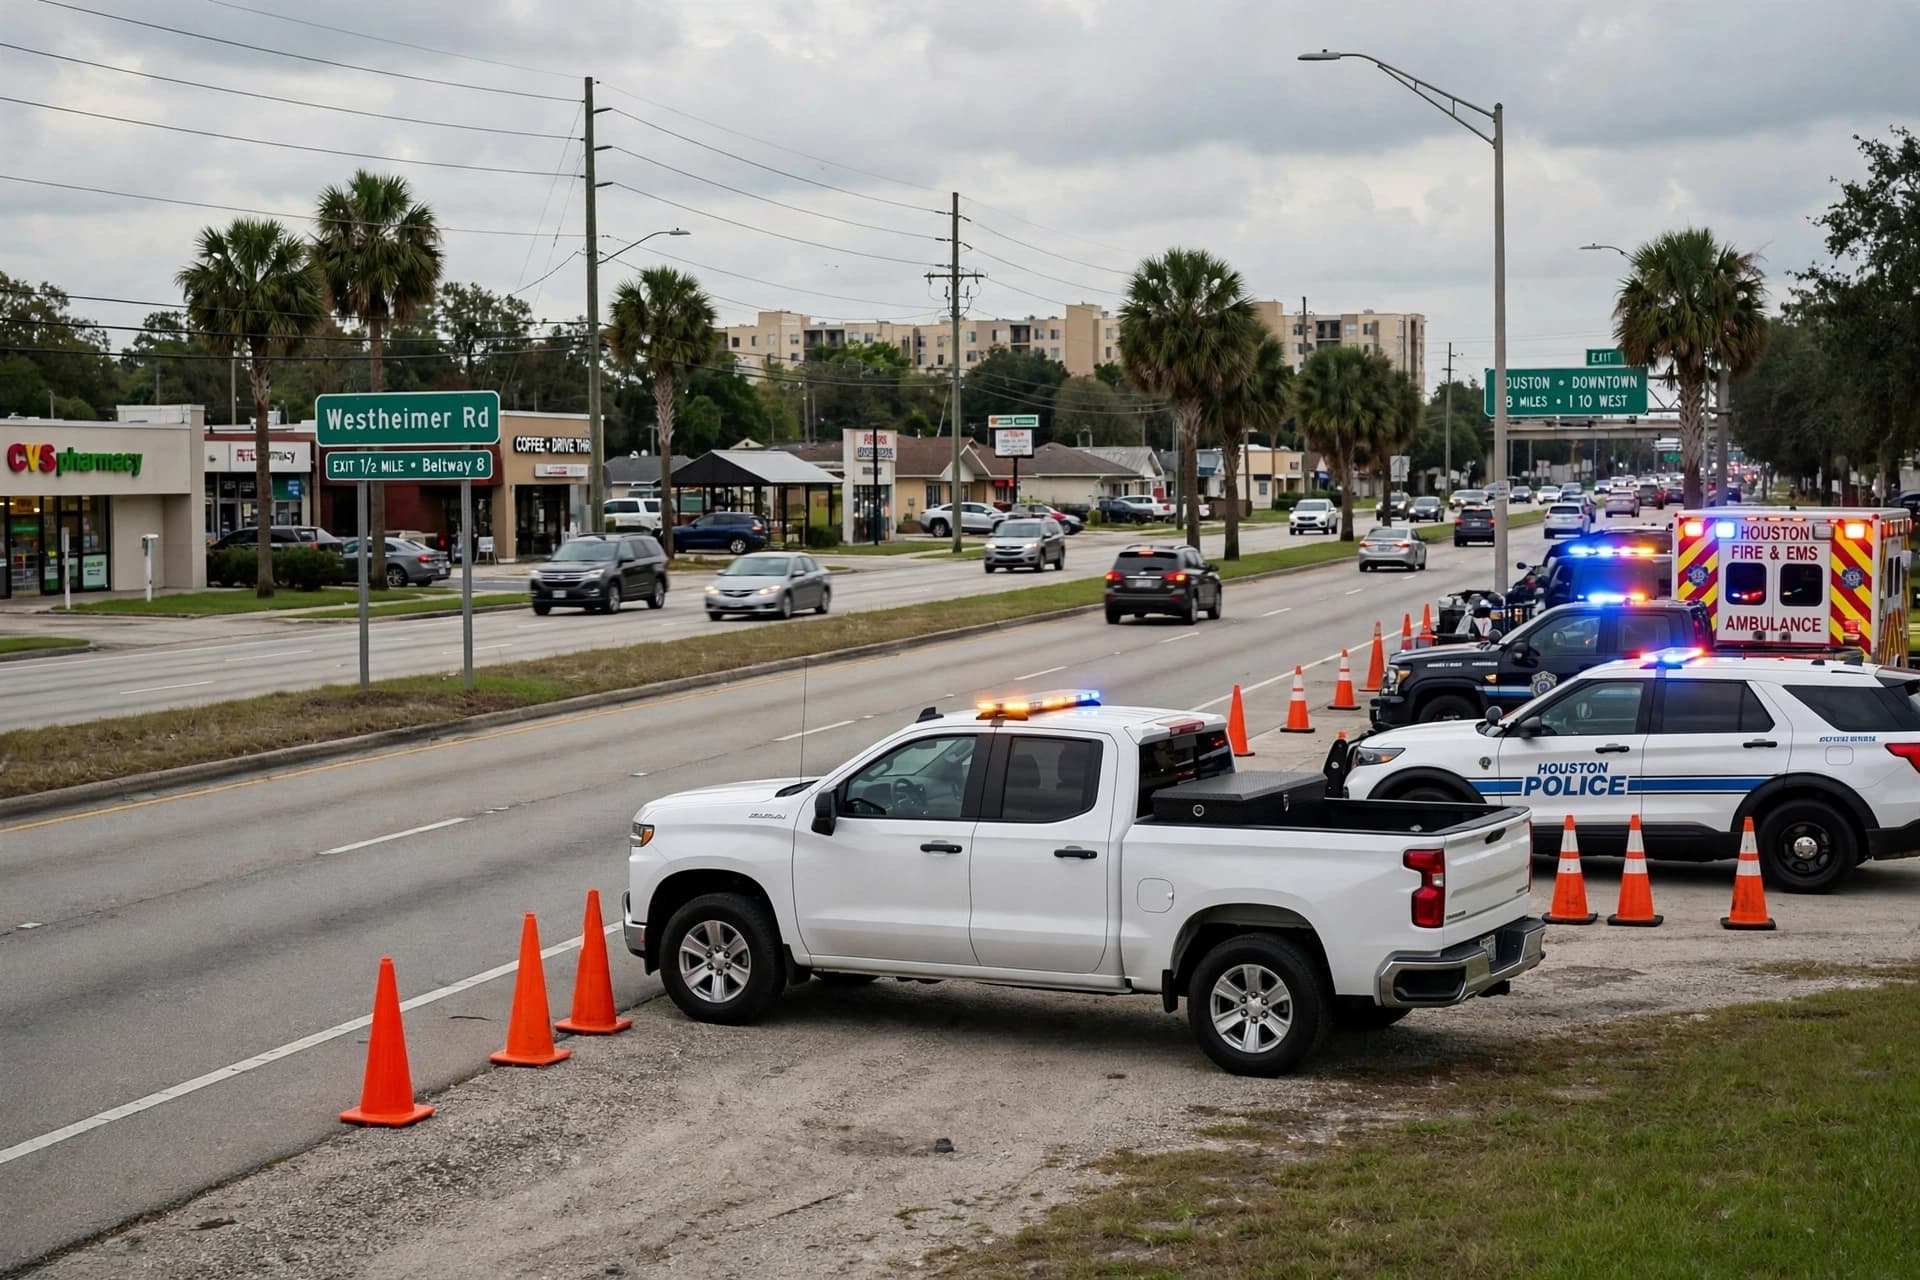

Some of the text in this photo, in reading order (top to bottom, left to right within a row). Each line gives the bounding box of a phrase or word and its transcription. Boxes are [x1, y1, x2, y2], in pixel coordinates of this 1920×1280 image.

[1505, 375, 1638, 390] OUSTON DOWNTOWN
[1519, 395, 1548, 408] MILES
[1578, 394, 1593, 408] 10
[1599, 394, 1628, 408] WEST
[326, 406, 489, 430] Westheimer Rd
[516, 436, 592, 453] COFFEE DRIVE THR
[7, 443, 143, 477] CVS pharmacy
[333, 457, 485, 476] EXIT 1/2 MILE Beltway 8
[1740, 525, 1810, 541] HOUSTON
[1731, 545, 1818, 561] FIRE & EMS
[1725, 615, 1822, 632] AMBULANCE
[1537, 762, 1609, 775] HOUSTON
[1523, 775, 1627, 796] POLICE
